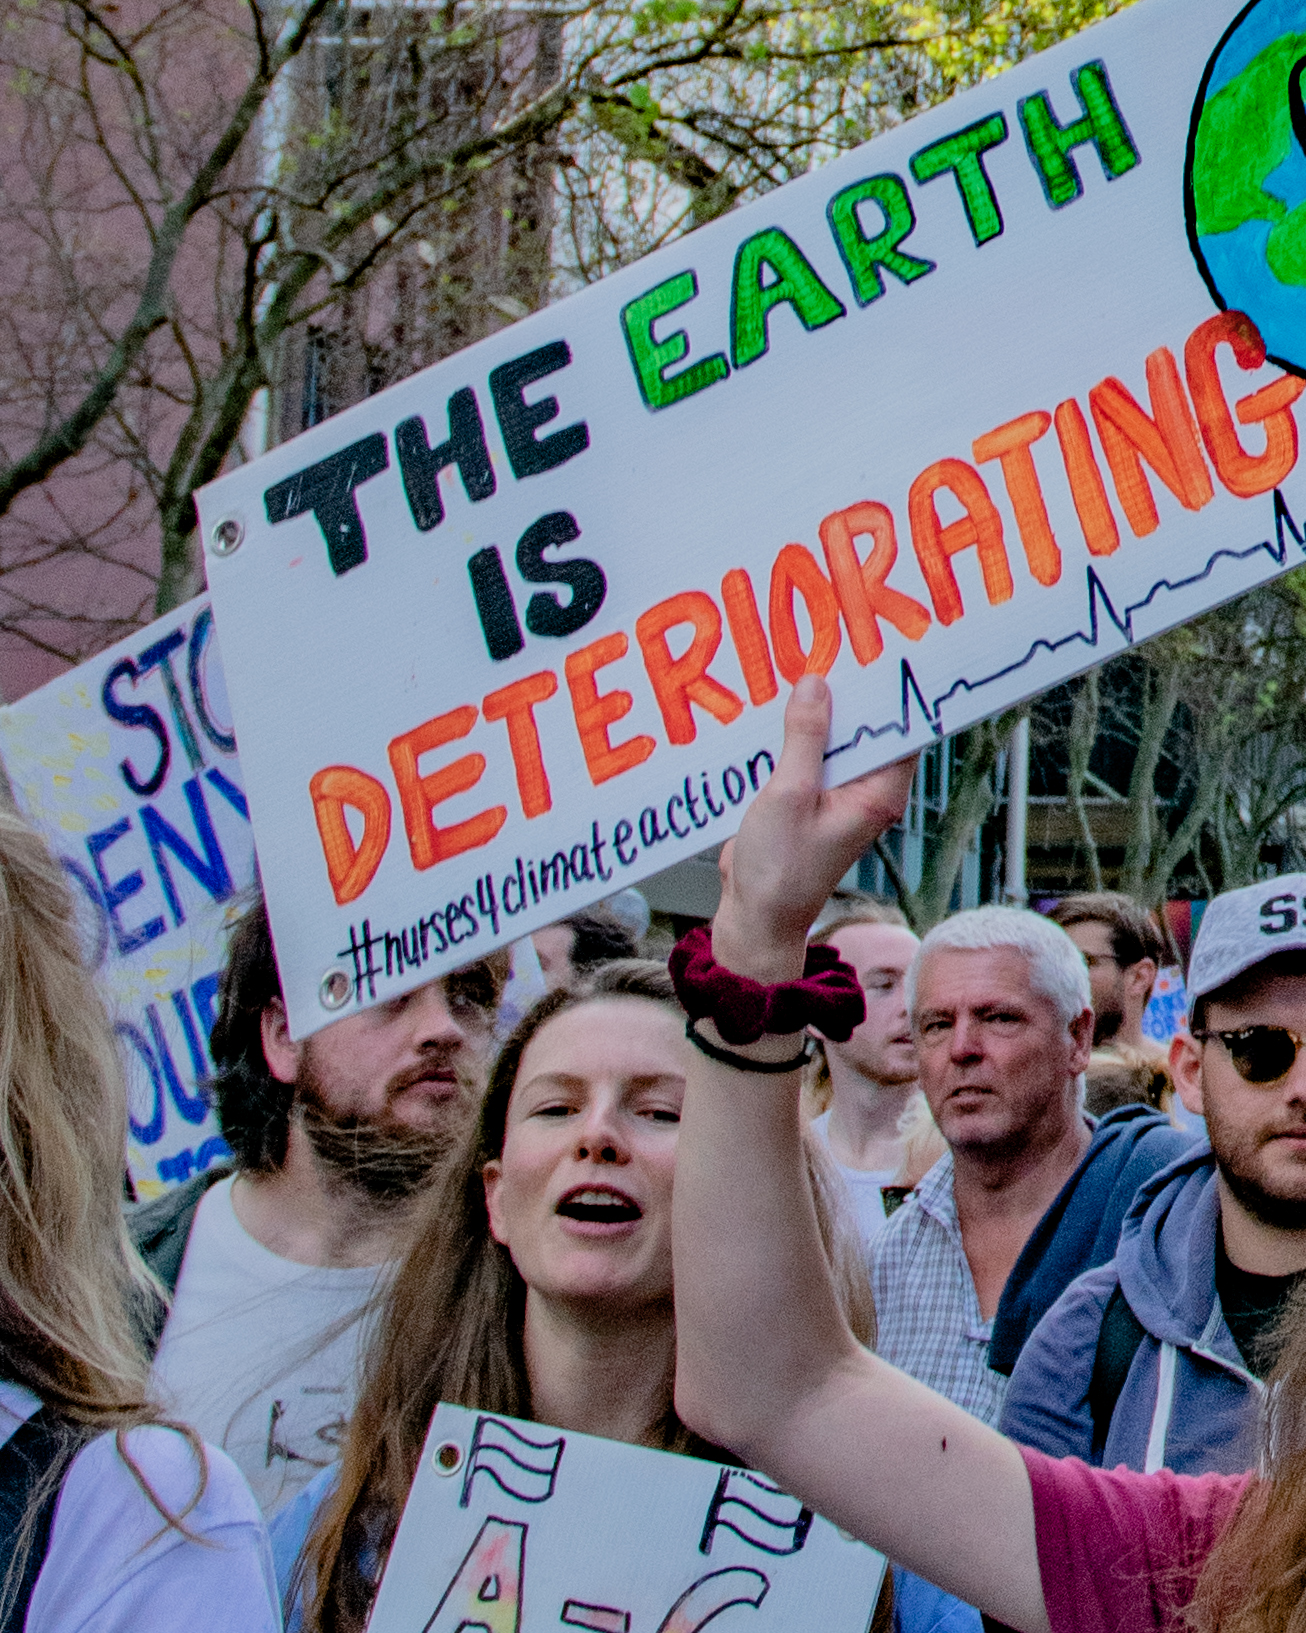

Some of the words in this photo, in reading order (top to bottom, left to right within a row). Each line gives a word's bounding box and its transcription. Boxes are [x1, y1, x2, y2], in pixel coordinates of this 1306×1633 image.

[263, 340, 590, 577] THE
[620, 58, 1141, 411] EARTH
[466, 510, 607, 661] IS
